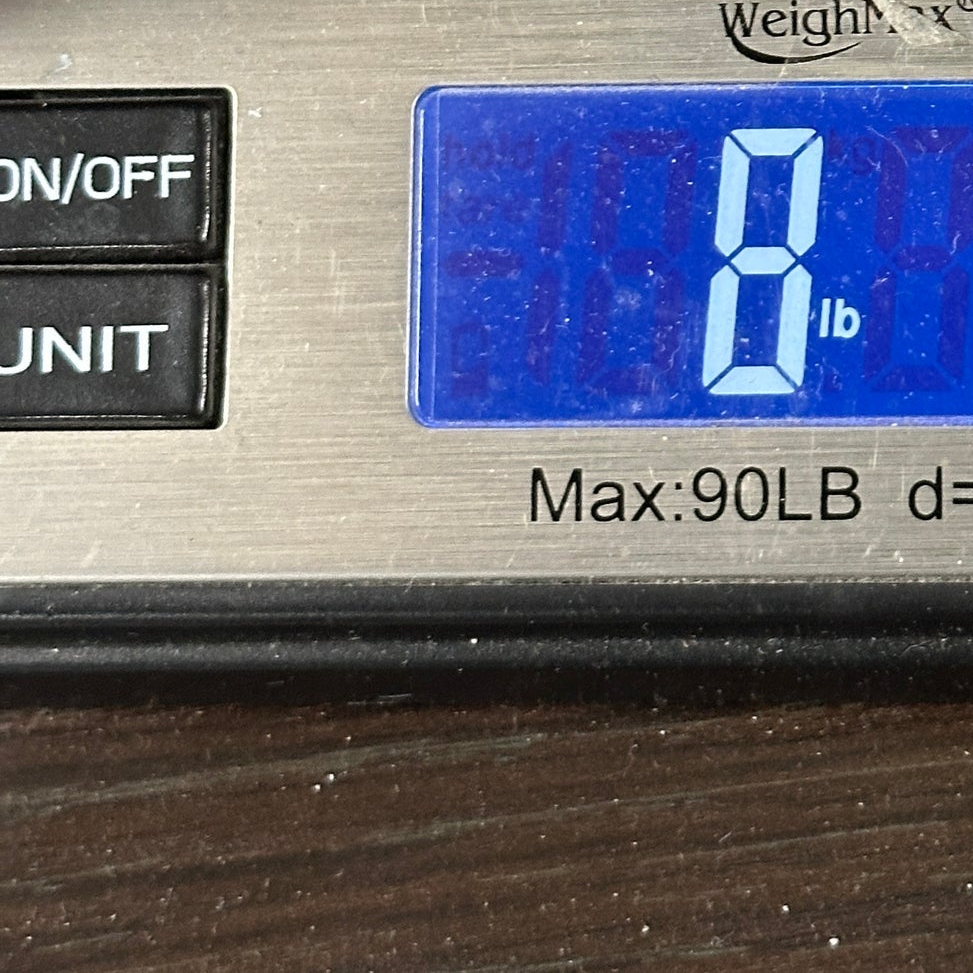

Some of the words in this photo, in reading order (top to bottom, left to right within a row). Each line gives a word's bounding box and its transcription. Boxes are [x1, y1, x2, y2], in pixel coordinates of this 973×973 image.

[819, 304, 861, 340] lb
[0, 324, 169, 375] UNIT
[529, 466, 862, 523] Max:90LB
